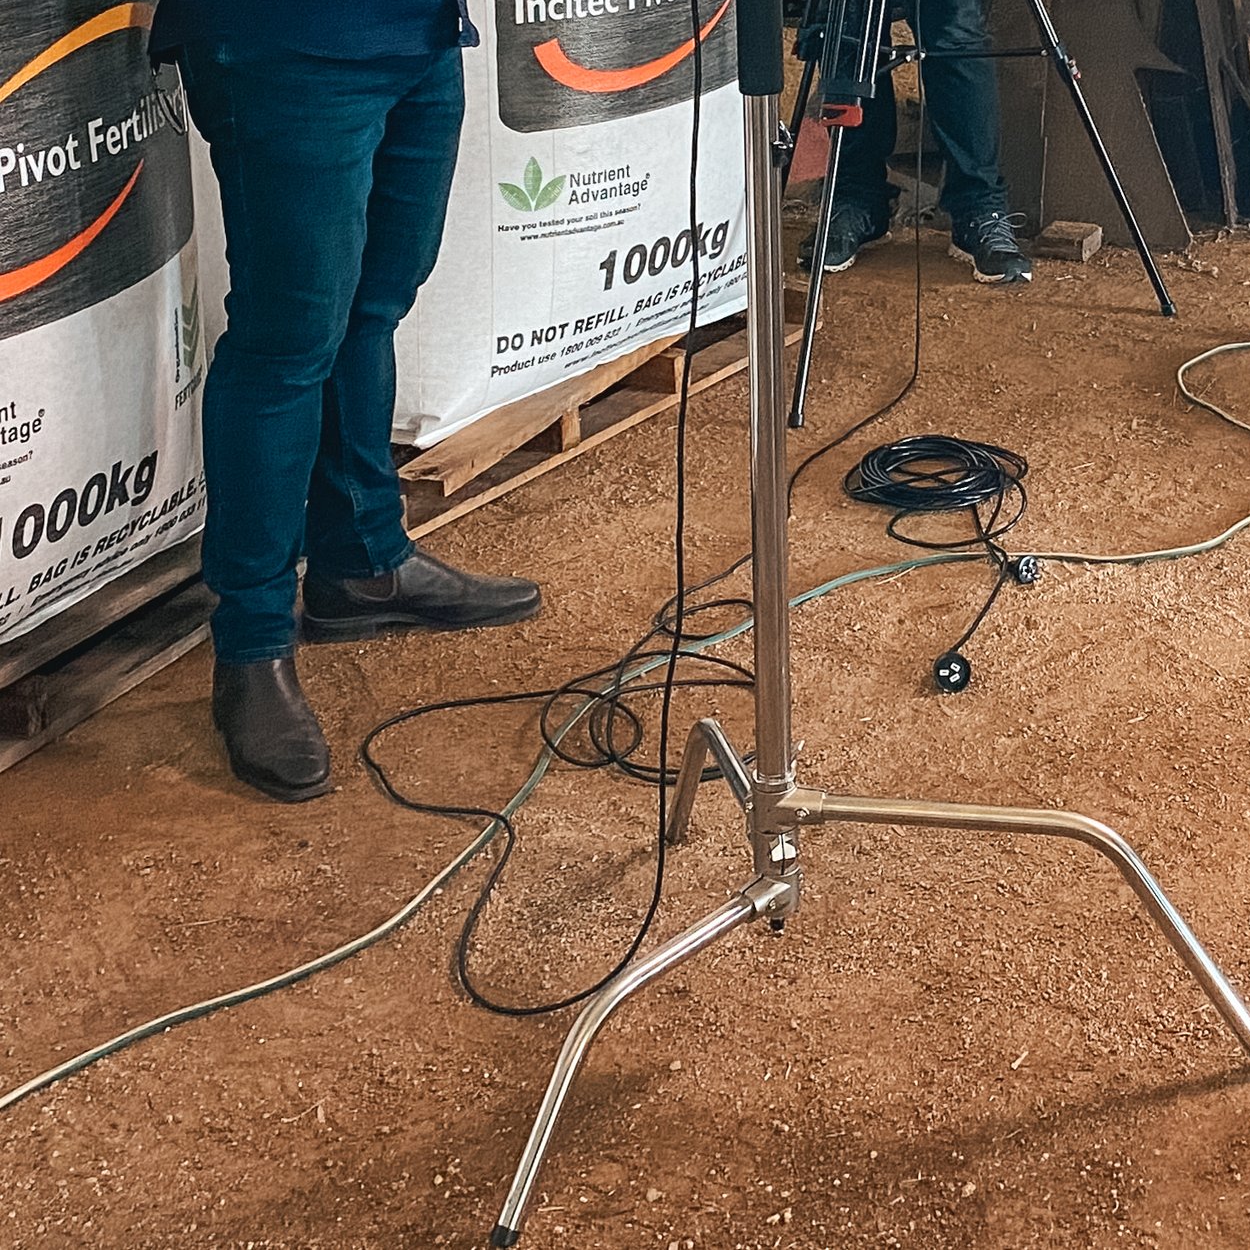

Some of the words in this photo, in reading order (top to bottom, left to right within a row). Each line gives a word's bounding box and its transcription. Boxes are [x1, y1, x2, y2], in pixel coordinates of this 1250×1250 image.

[0, 133, 81, 193] Pivot
[569, 164, 631, 188] Nutrient
[522, 223, 537, 232] you
[539, 218, 565, 228] tested
[566, 216, 584, 226] your
[585, 213, 598, 221] soil
[600, 210, 613, 219] this
[614, 203, 641, 216] season?
[599, 219, 730, 292] 1000kg
[496, 332, 525, 355] DO
[530, 322, 570, 347] NOT
[633, 291, 663, 315] BAG
[664, 284, 680, 302] IS
[490, 356, 536, 378] Product
[537, 352, 557, 365] use
[0, 450, 159, 560] 000kg
[26, 558, 69, 595] BAG
[70, 545, 92, 570] IS
